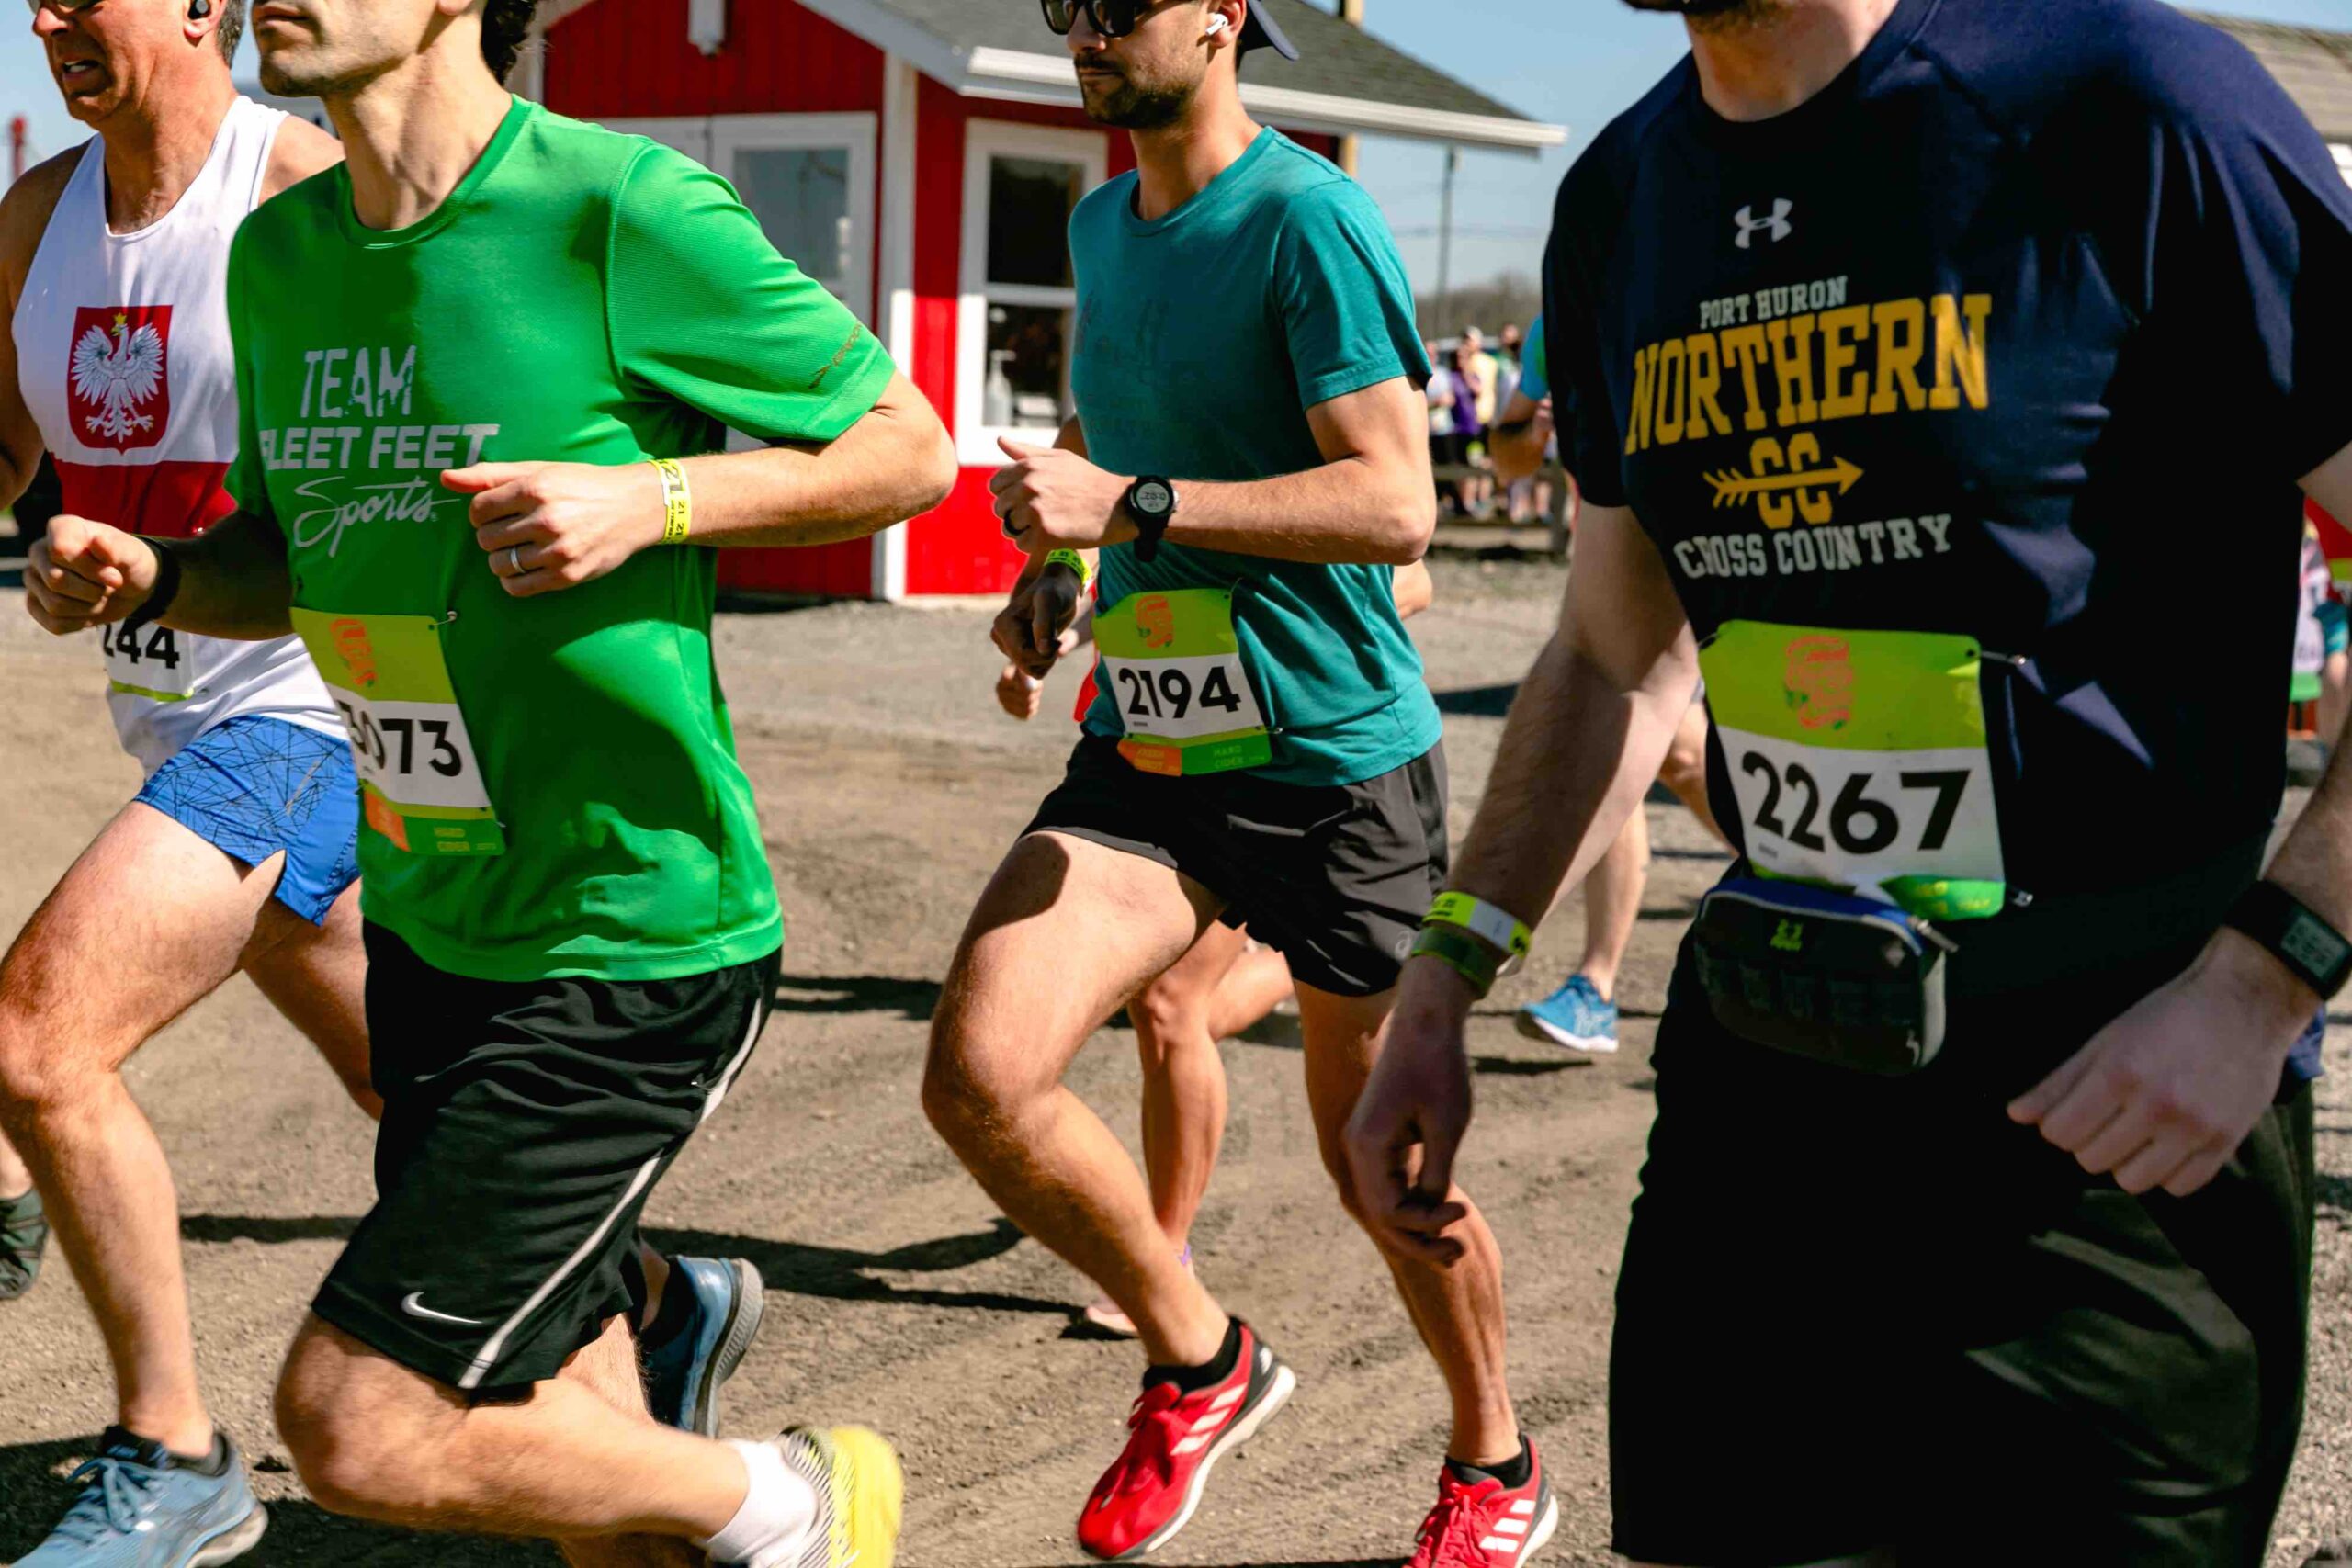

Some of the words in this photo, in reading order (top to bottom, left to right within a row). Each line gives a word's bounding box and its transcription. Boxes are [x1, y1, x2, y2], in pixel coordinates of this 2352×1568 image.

[1700, 294, 1750, 330] PORT
[1755, 276, 1848, 320] HURON
[300, 344, 416, 418] TEAM
[1624, 293, 1992, 456] NORTHERN
[368, 423, 501, 470] FEET
[293, 474, 461, 558] Sports
[1773, 514, 1951, 575] COUNTRY
[1118, 665, 1242, 719] 2194
[1741, 750, 1972, 855] 2267
